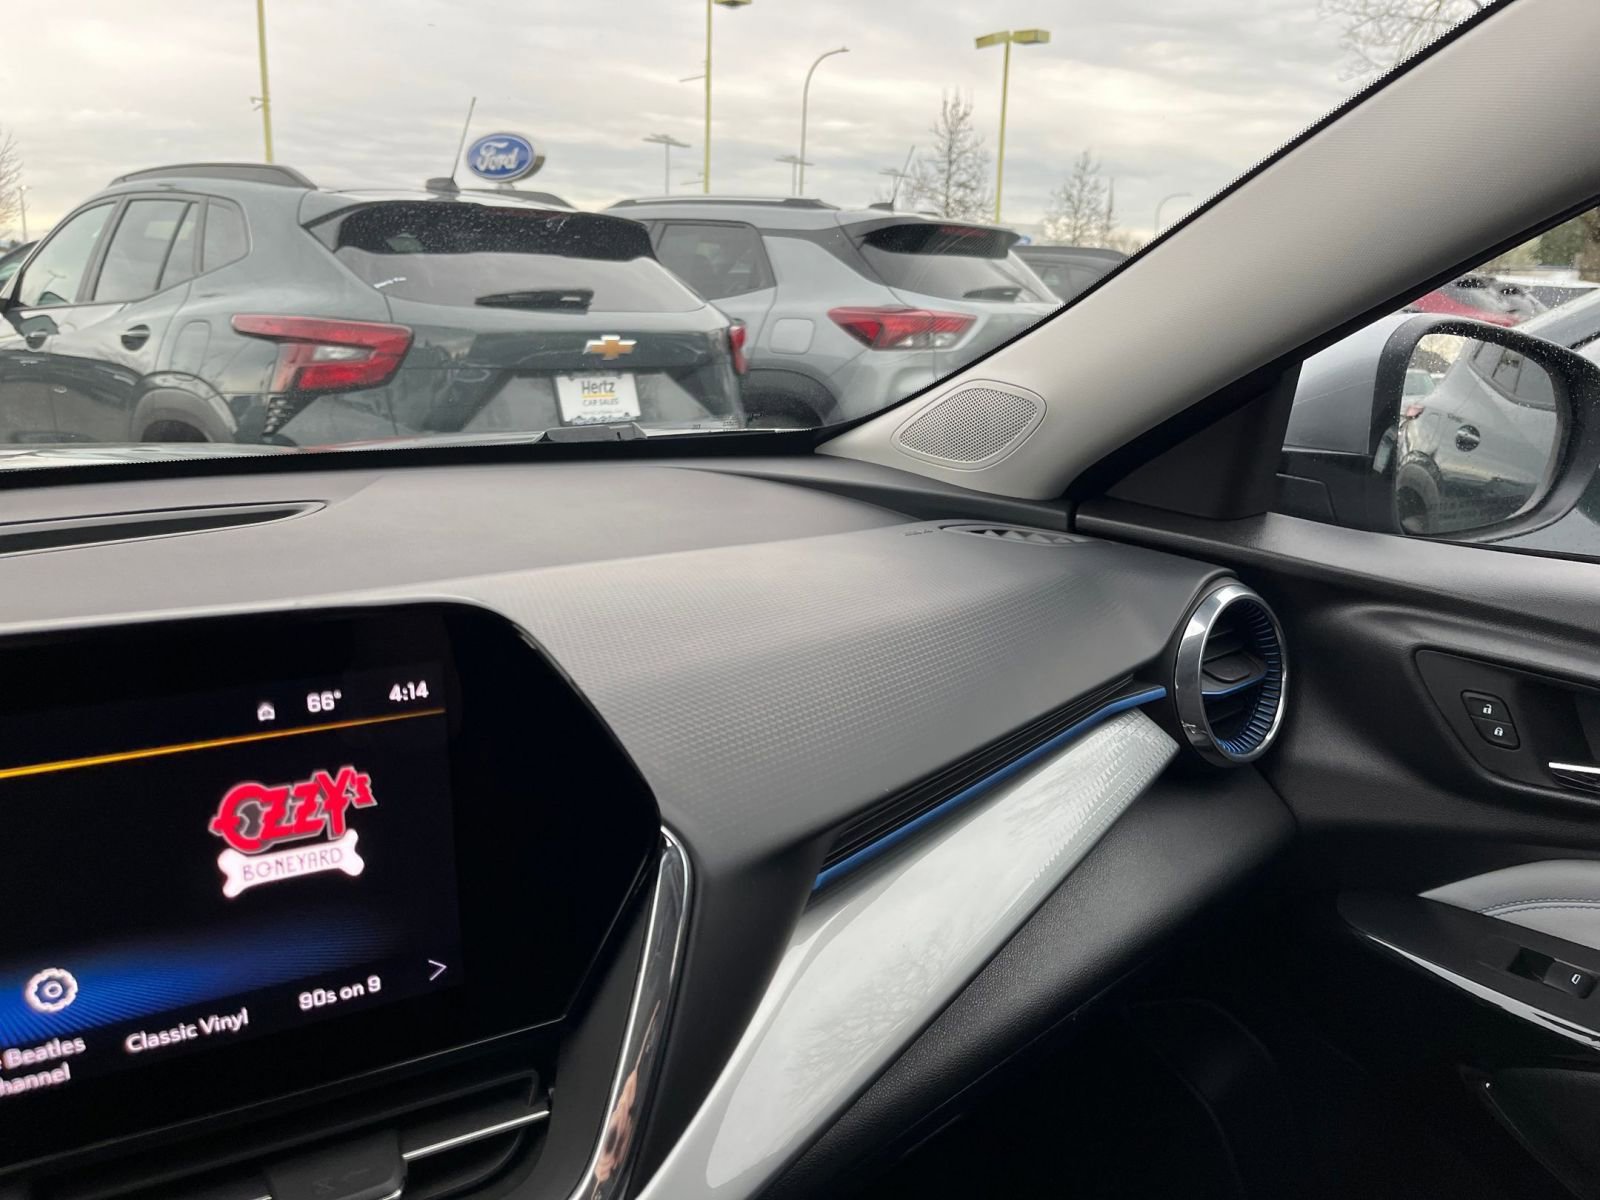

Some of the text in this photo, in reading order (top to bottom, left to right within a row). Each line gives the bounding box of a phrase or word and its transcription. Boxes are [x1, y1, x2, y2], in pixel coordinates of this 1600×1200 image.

[476, 141, 519, 171] Ford
[581, 380, 616, 394] Hertz
[582, 397, 620, 407] CAR SALES
[389, 680, 429, 702] 4:14
[242, 847, 344, 882] BONEYARD
[299, 974, 382, 1011] 90s on 9
[125, 1006, 249, 1053] Classic Vinyl
[2, 1037, 87, 1070] Beatles
